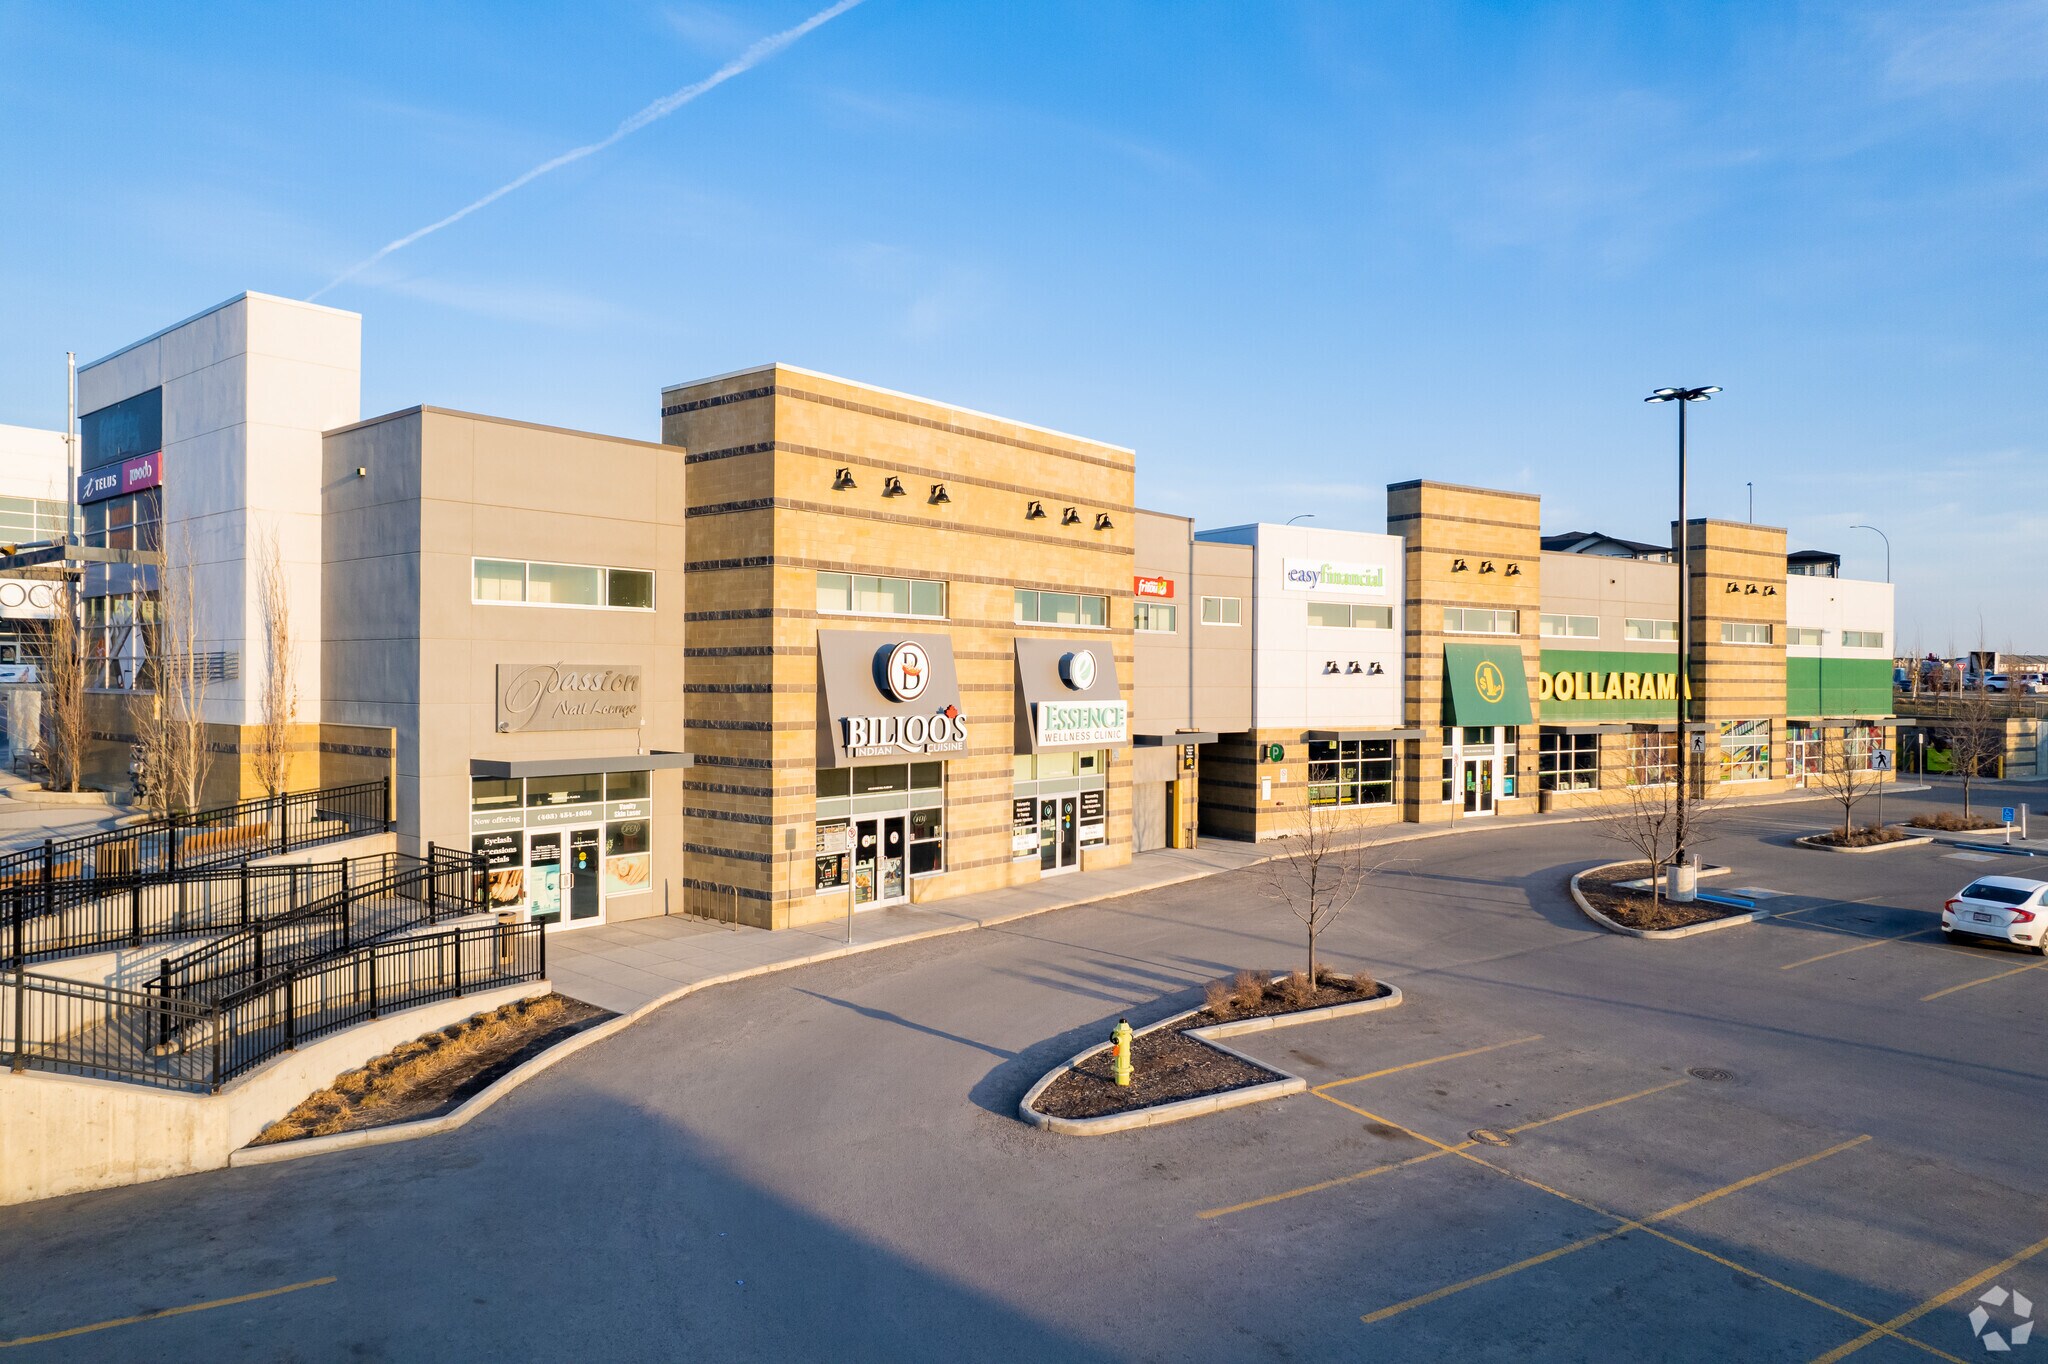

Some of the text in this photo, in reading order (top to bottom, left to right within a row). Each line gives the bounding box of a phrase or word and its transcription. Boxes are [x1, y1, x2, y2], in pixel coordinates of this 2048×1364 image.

[130, 460, 152, 485] koodo
[95, 475, 116, 491] TELUS
[1288, 563, 1383, 589] easyfinancial
[501, 660, 640, 733] Passion
[552, 699, 637, 718] Nail Lounge
[1045, 730, 1121, 742] WELLNESS CLINIC
[856, 742, 963, 757] INDIAN CUISINE
[1272, 746, 1279, 759] P
[491, 815, 521, 824] offering
[484, 836, 512, 846] Eyelash
[488, 855, 510, 864] acials
